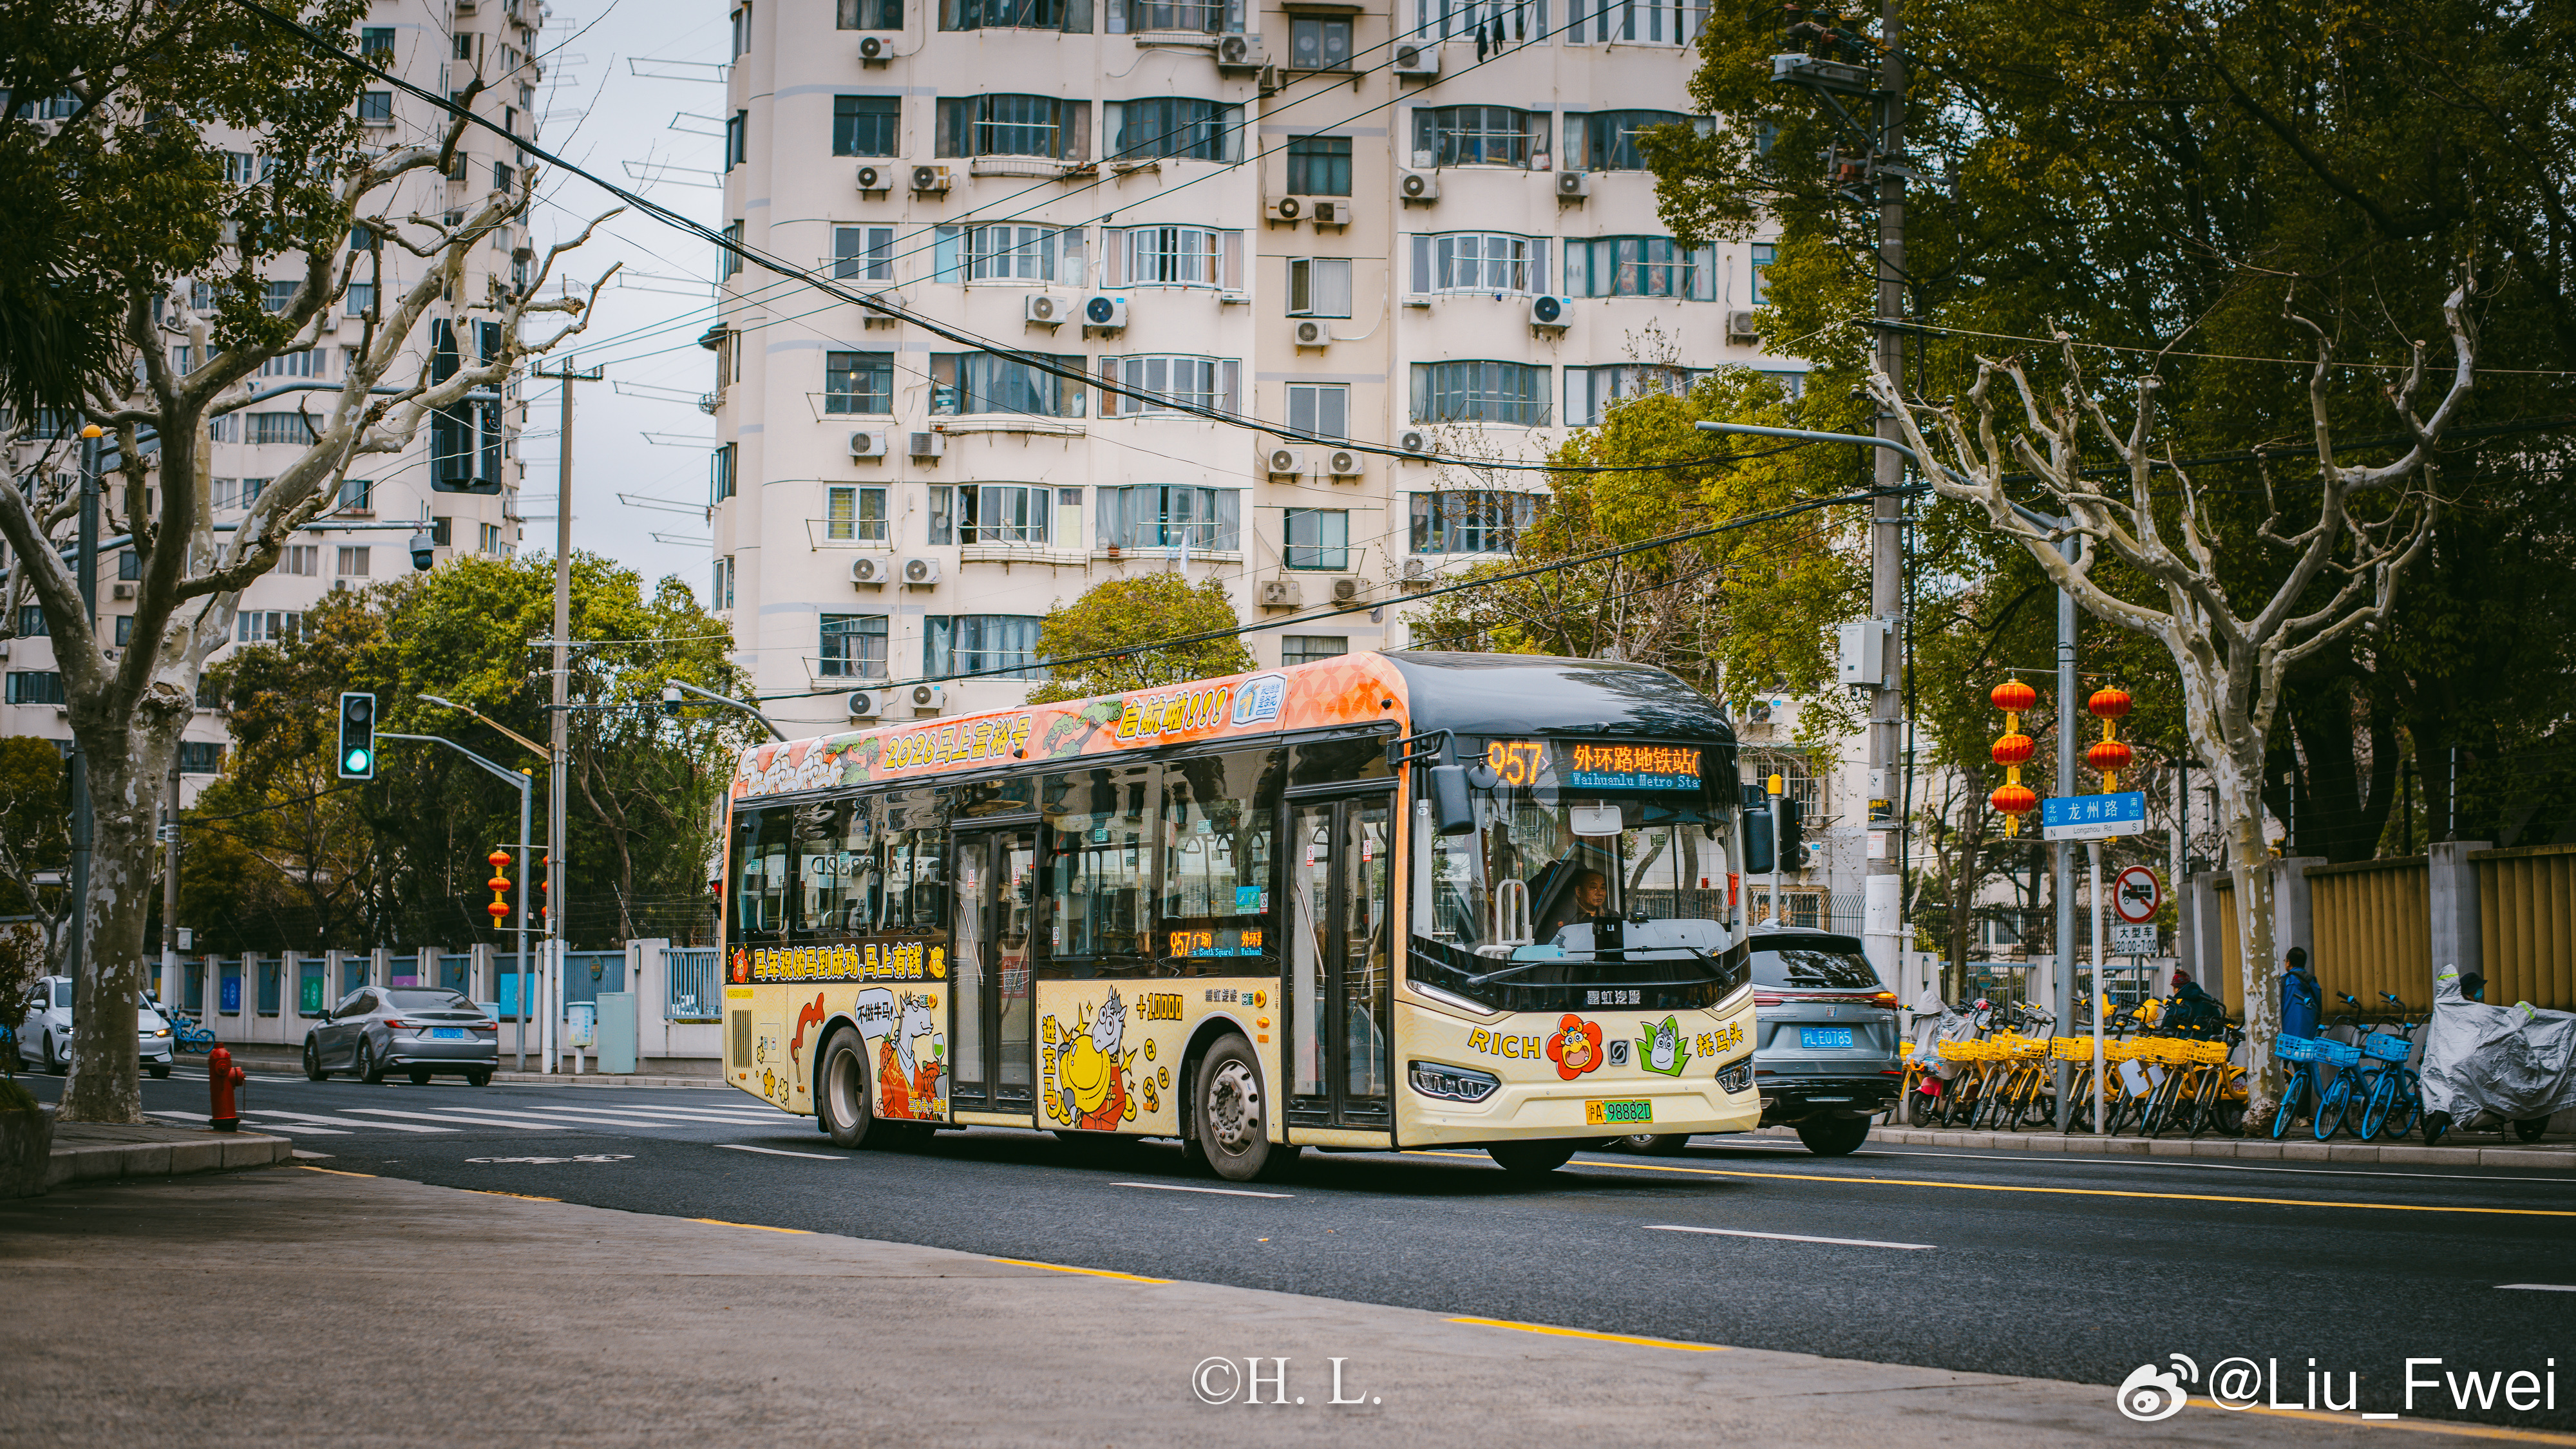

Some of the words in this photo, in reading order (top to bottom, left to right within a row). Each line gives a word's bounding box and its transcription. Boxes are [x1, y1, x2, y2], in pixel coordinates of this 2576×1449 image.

[1117, 689, 1227, 739] 启航啦!!!
[883, 715, 1031, 771] 2026马上富裕号
[1488, 743, 1542, 784] 957
[1574, 745, 1701, 777] 外环路地铁站(
[1573, 773, 1634, 786] Waihuanlu
[1639, 774, 1673, 786] Metro
[1678, 775, 1701, 787] Sta
[2049, 804, 2057, 814] 北
[2068, 800, 2118, 820] 龙州路
[2130, 797, 2138, 808] 南
[2050, 829, 2056, 837] N
[2073, 826, 2100, 835] Longzhou
[2132, 823, 2137, 831] S
[2119, 926, 2153, 938] 大型车
[1170, 932, 1190, 957] 957
[1199, 947, 1215, 956] (South
[1215, 947, 1233, 957] Square)
[2116, 940, 2157, 952] 20:00-7:00
[754, 942, 923, 981] 马年祝侬马到成功,马上有钱
[857, 1001, 894, 1024] 不做牛马!
[1467, 1027, 1541, 1059] RICH
[1695, 1021, 1744, 1058] 托马头
